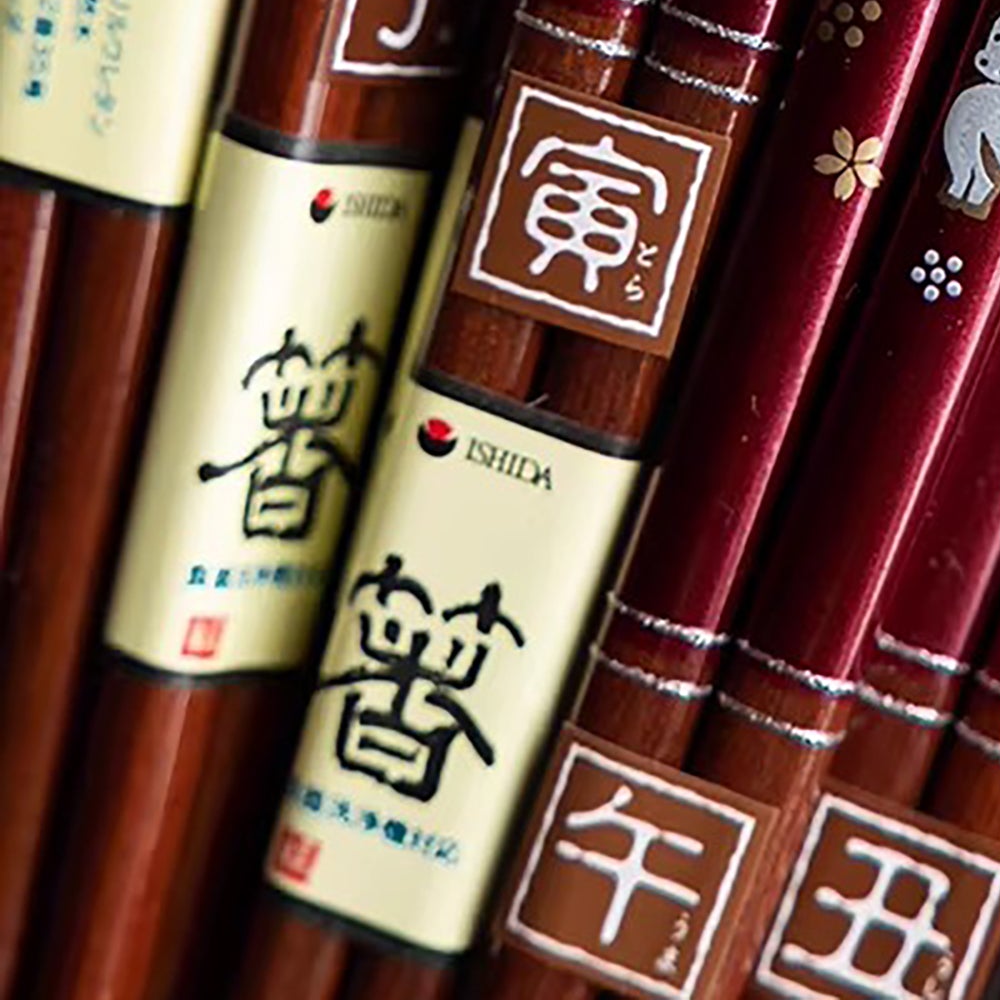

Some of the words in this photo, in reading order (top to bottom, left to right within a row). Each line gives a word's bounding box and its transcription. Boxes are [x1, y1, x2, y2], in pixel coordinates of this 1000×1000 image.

[520, 134, 669, 293] 寅
[625, 241, 659, 301] とら
[465, 437, 553, 491] ISHIDA
[555, 783, 706, 947] 午
[780, 836, 952, 1000] 丑
